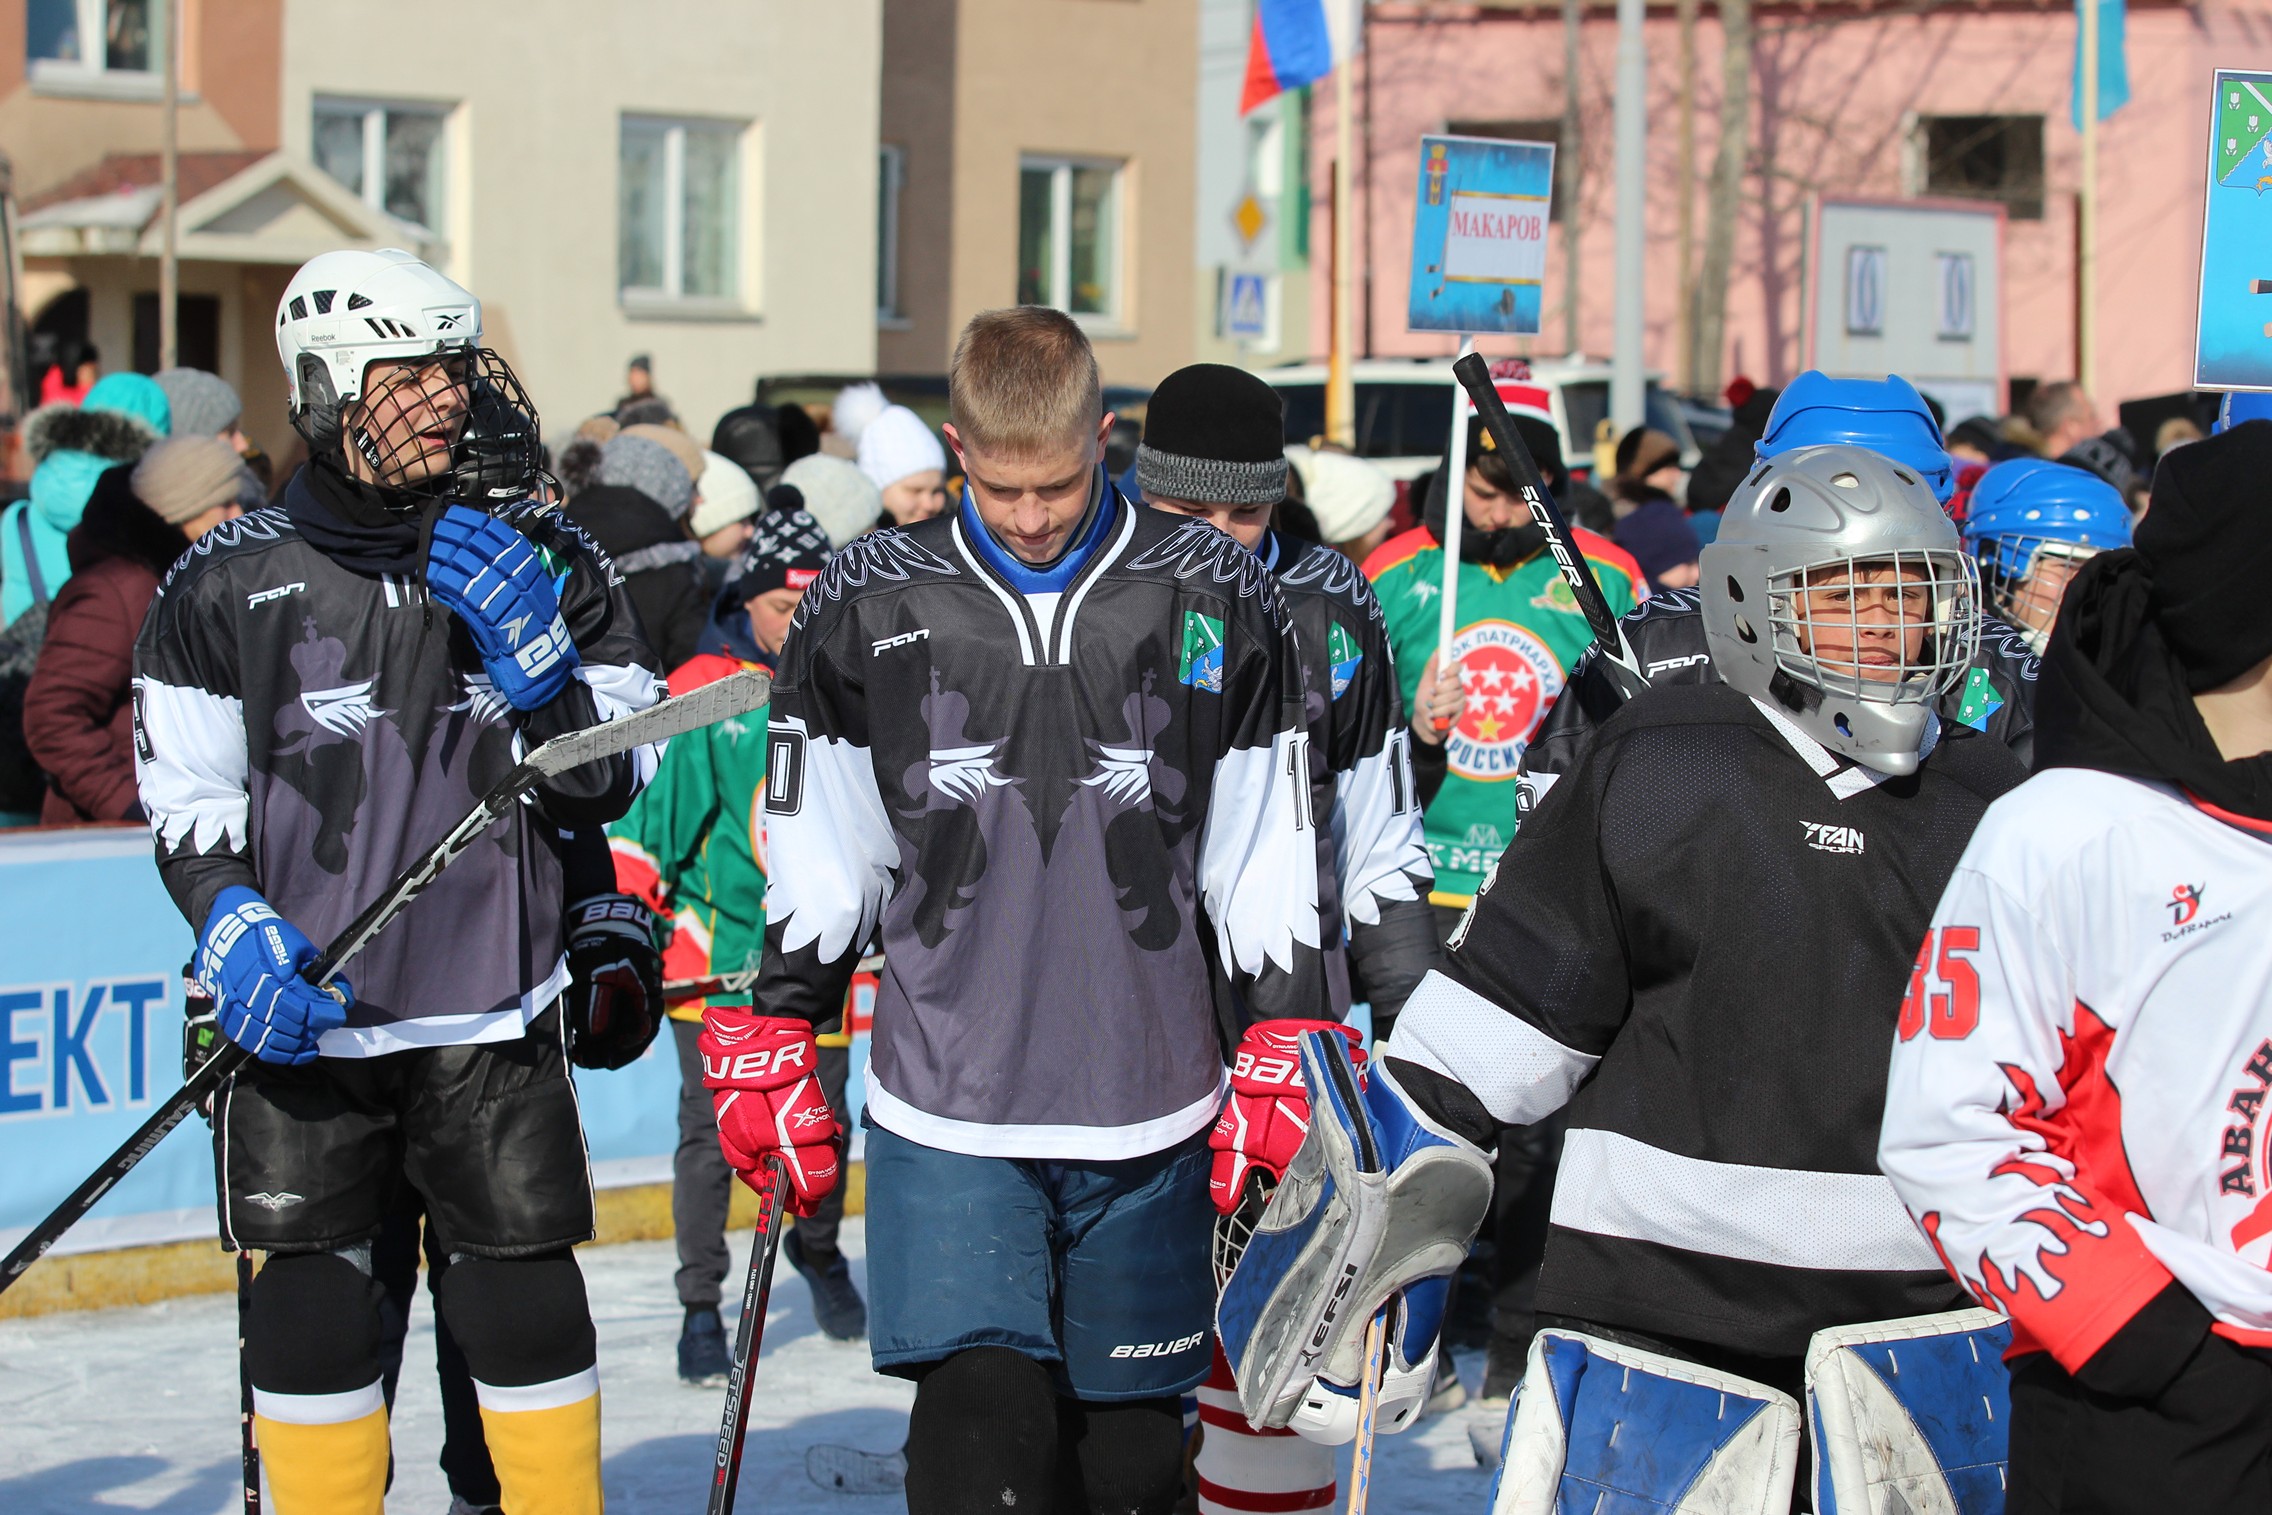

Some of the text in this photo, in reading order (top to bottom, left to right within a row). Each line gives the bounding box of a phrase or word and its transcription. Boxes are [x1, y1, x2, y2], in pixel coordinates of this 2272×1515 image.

[1452, 211, 1541, 240] МАКАРОВ
[311, 333, 336, 342] Reebok
[700, 1041, 807, 1080] UER
[1109, 1331, 1204, 1358] BAUER
[717, 1350, 745, 1468] JETSPEED
